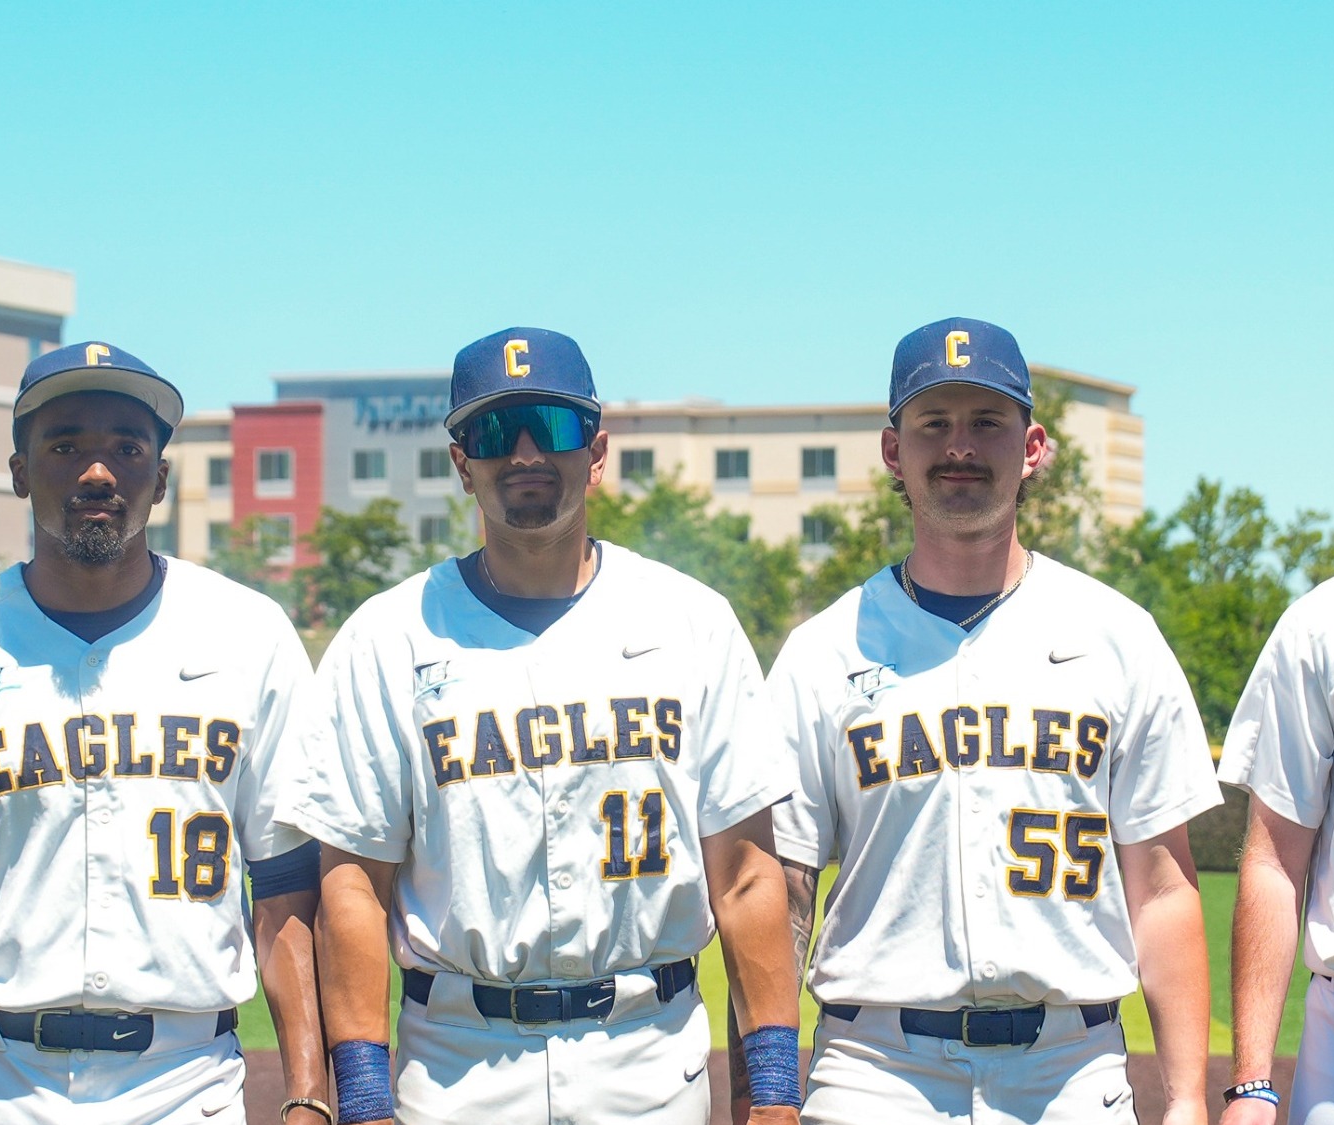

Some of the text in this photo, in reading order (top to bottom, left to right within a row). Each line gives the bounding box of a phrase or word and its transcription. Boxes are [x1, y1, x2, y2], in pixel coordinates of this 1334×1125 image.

[86, 343, 112, 366] C
[504, 339, 531, 378] C
[945, 330, 970, 368] C
[423, 697, 682, 789] EAGLES
[846, 705, 1110, 790] EAGLES
[147, 808, 232, 902] 18
[599, 788, 670, 881] 11
[1005, 808, 1109, 900] 55
